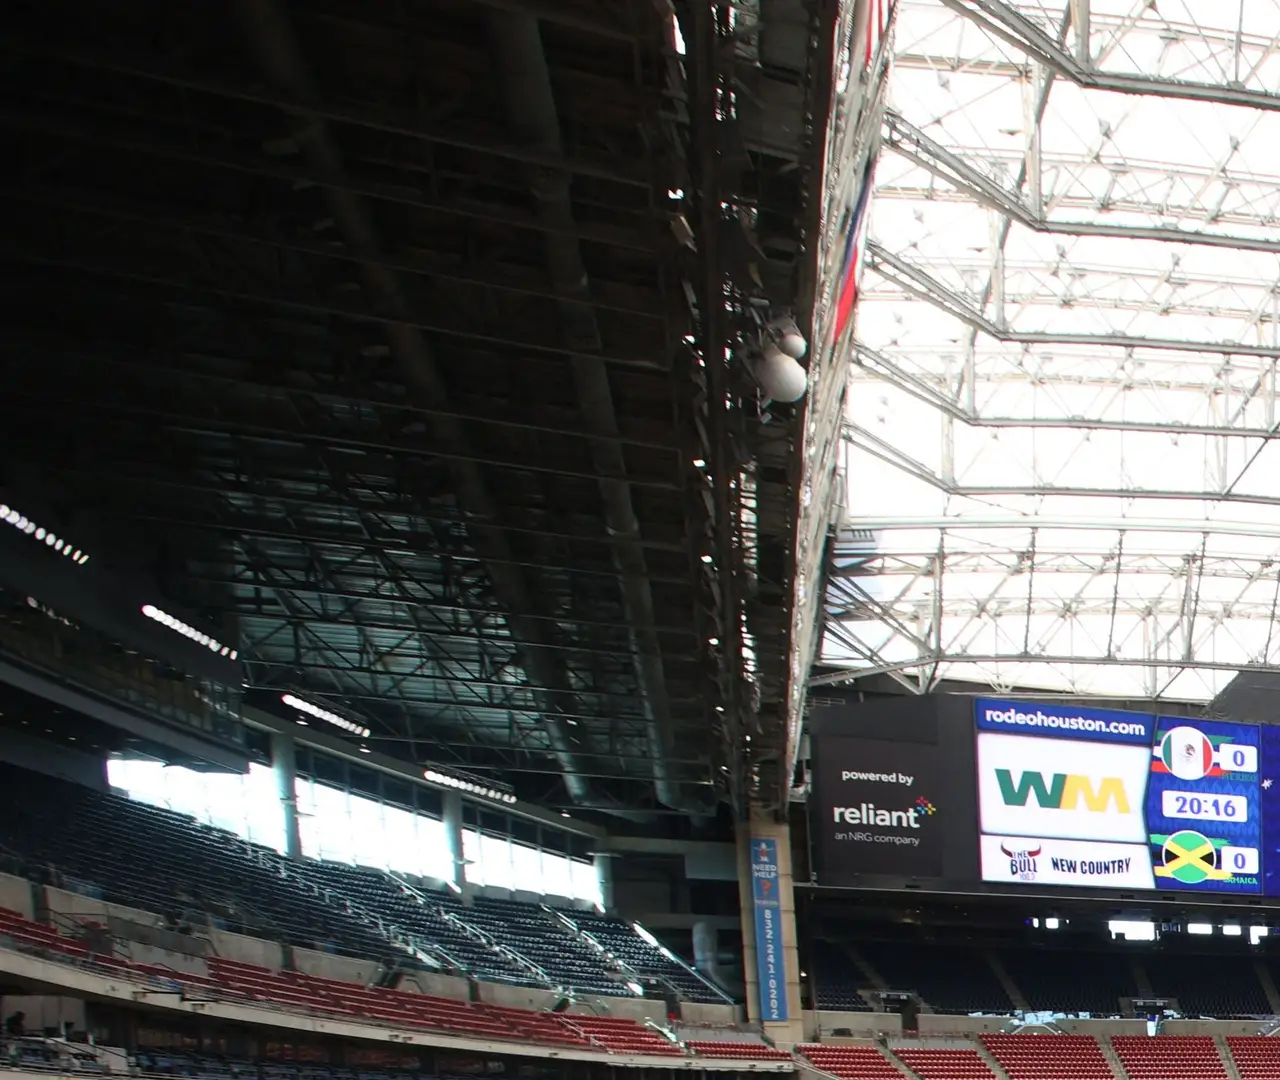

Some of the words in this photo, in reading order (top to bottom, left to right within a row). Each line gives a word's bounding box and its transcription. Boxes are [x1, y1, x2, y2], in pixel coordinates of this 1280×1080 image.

[985, 707, 1145, 737] rodeohouston.com
[1232, 750, 1245, 767] 0
[841, 769, 896, 785] powered
[898, 772, 913, 786] by
[994, 768, 1130, 814] WM
[833, 800, 920, 828] reliant
[1176, 796, 1235, 818] 20:16
[834, 833, 847, 842] an
[848, 831, 873, 843] NRG
[874, 835, 920, 847] company
[1010, 858, 1038, 876] BULL
[1051, 857, 1077, 874] NEW
[1080, 858, 1131, 874] COUNTRY
[1233, 852, 1246, 870] 0
[753, 871, 777, 879] HELP
